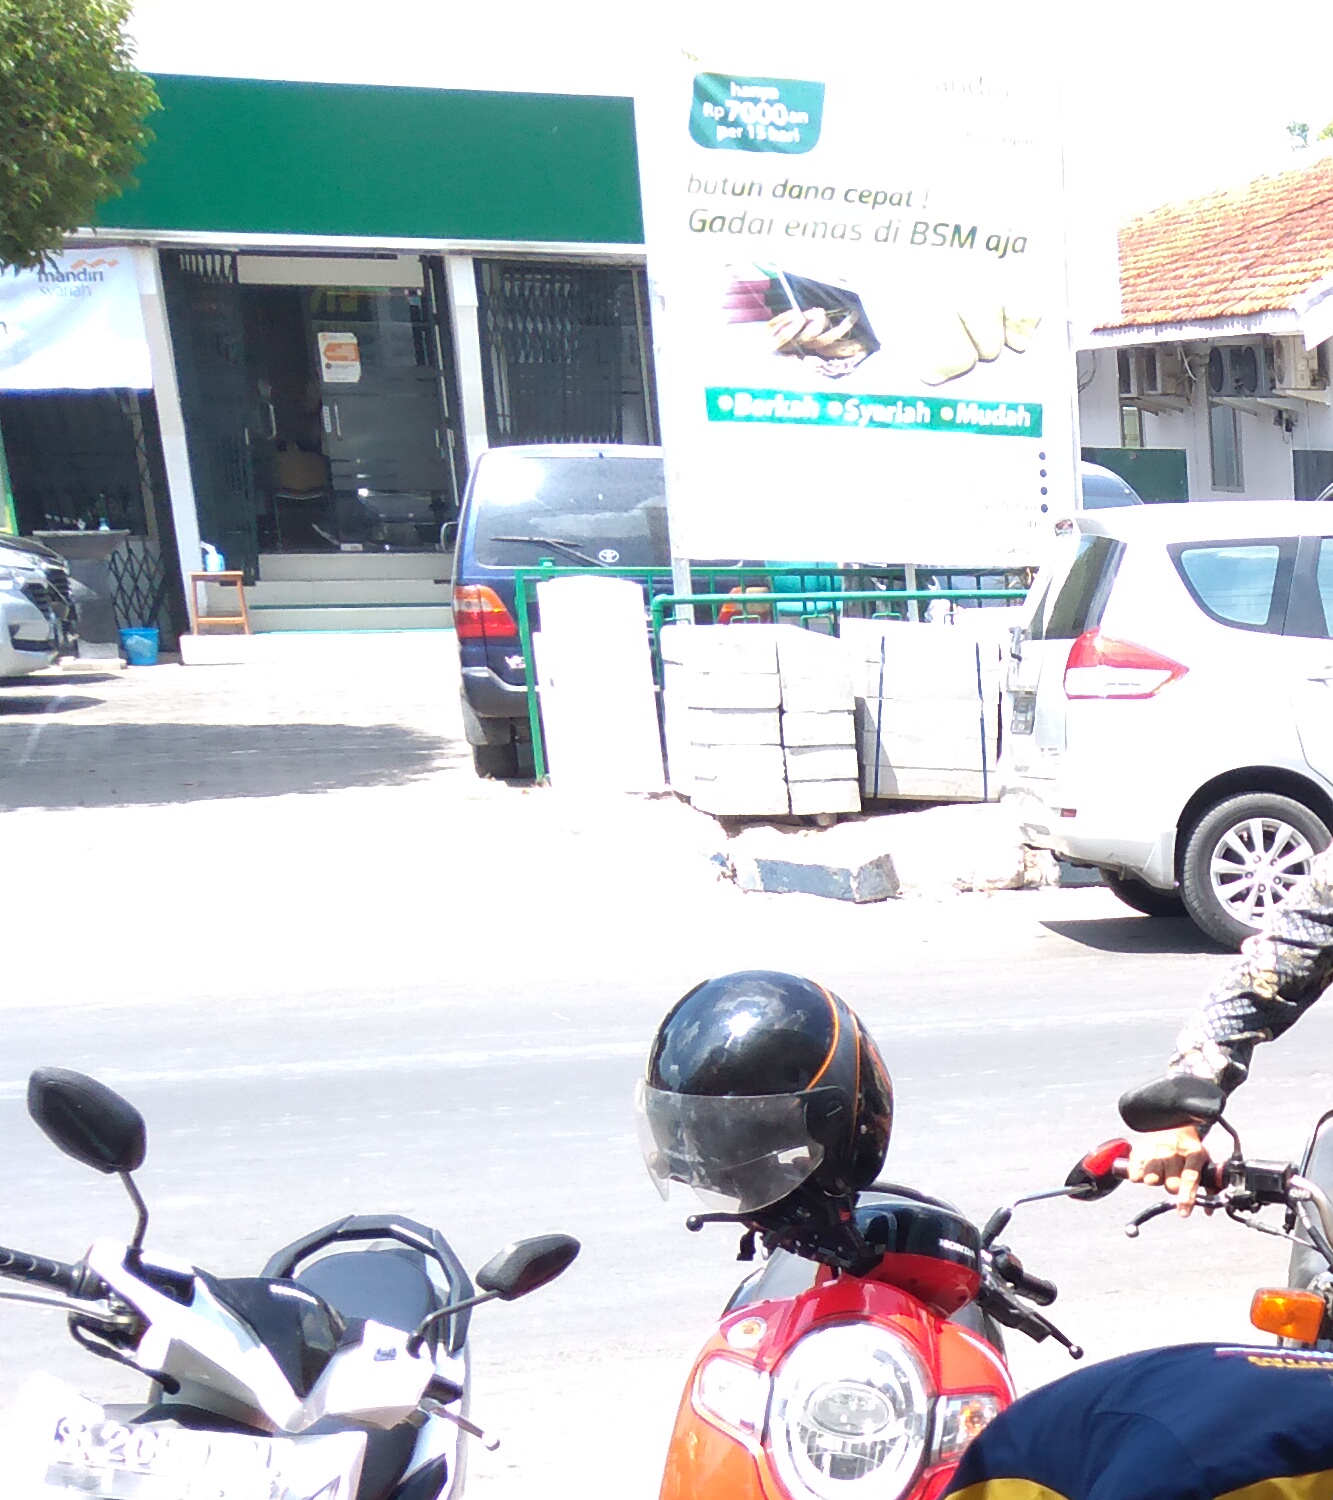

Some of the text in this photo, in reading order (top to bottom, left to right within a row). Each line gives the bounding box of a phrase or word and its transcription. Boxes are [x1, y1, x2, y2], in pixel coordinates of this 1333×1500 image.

[747, 125, 767, 140] 15
[772, 179, 835, 201] dana
[843, 186, 915, 210] cepat
[785, 219, 863, 242] emas
[874, 219, 902, 245] di
[910, 221, 979, 250] BSM
[985, 227, 1029, 260] aja
[843, 398, 931, 428] Syariah
[955, 402, 1032, 428] Mudah
